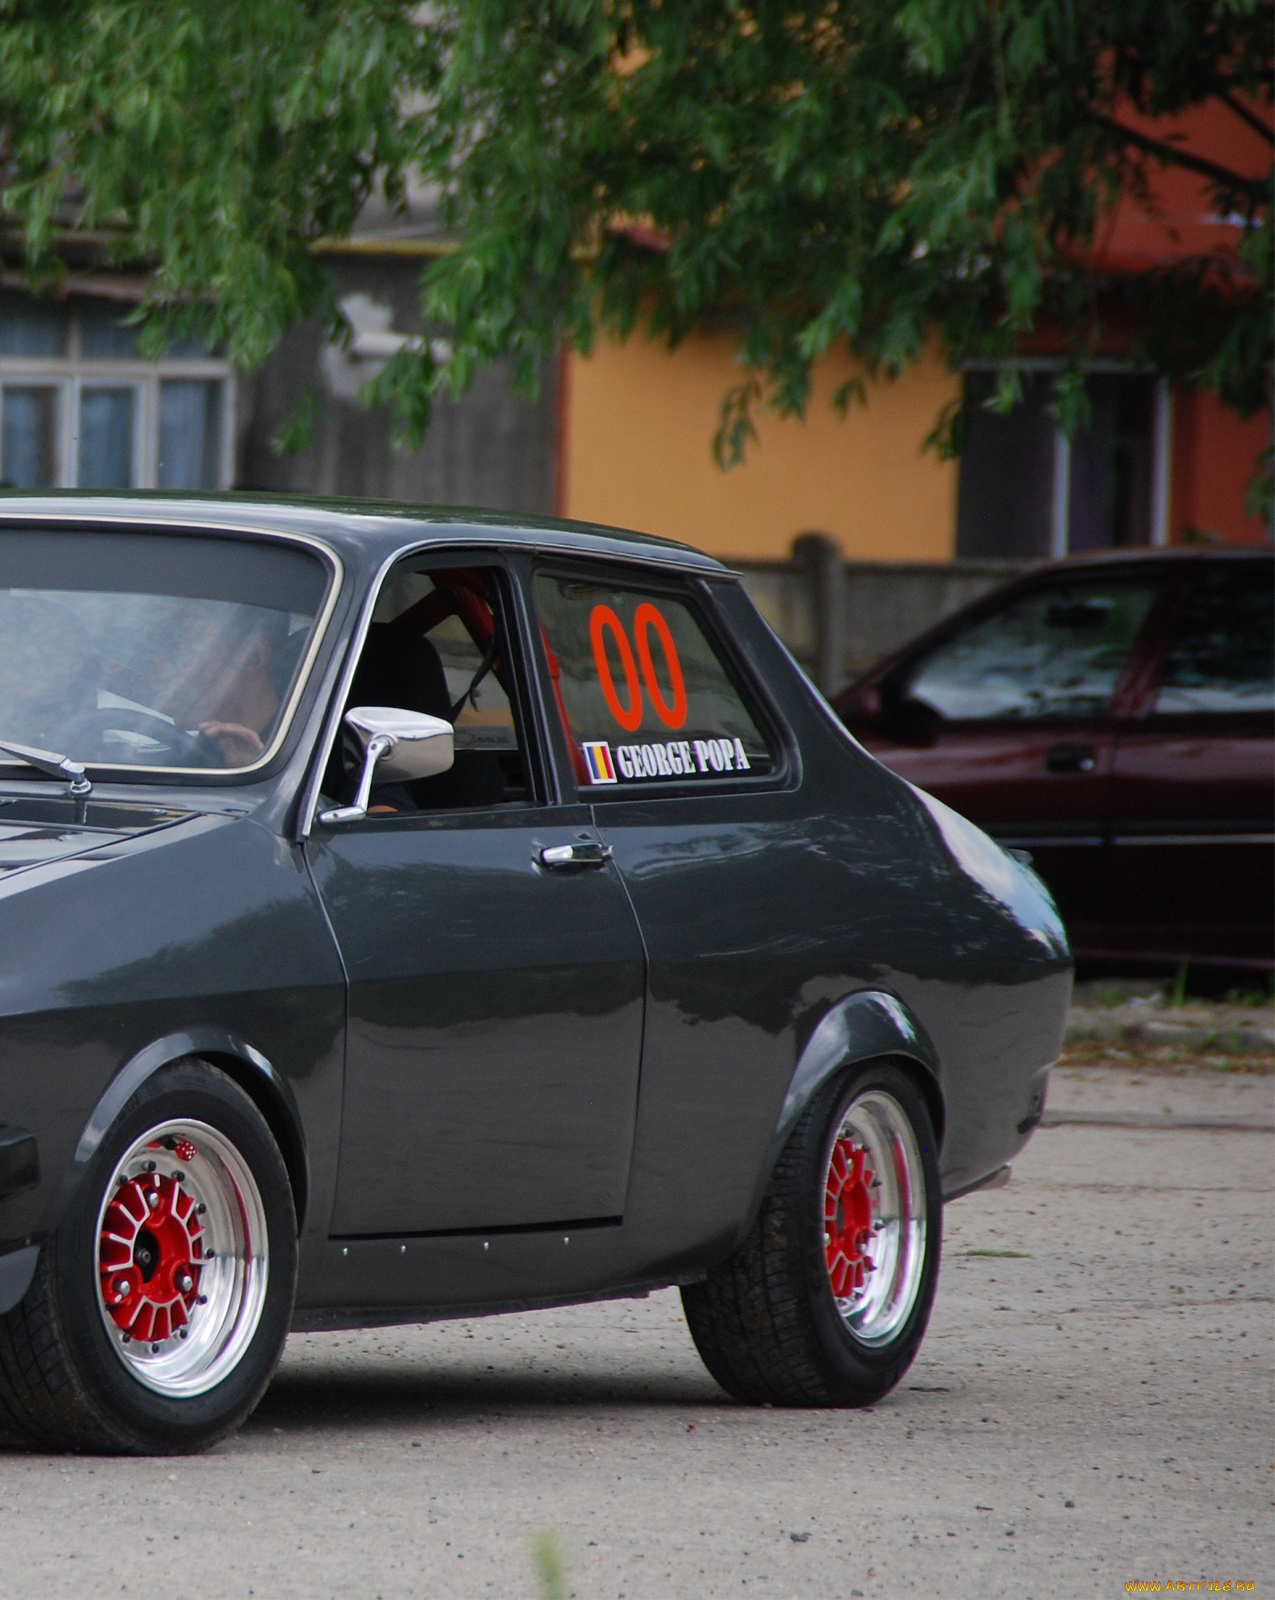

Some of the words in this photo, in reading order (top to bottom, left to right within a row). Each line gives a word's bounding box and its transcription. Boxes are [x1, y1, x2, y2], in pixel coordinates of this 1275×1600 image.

[590, 603, 687, 731] 00
[617, 741, 696, 778] GEORGE
[693, 738, 751, 772] POPA
